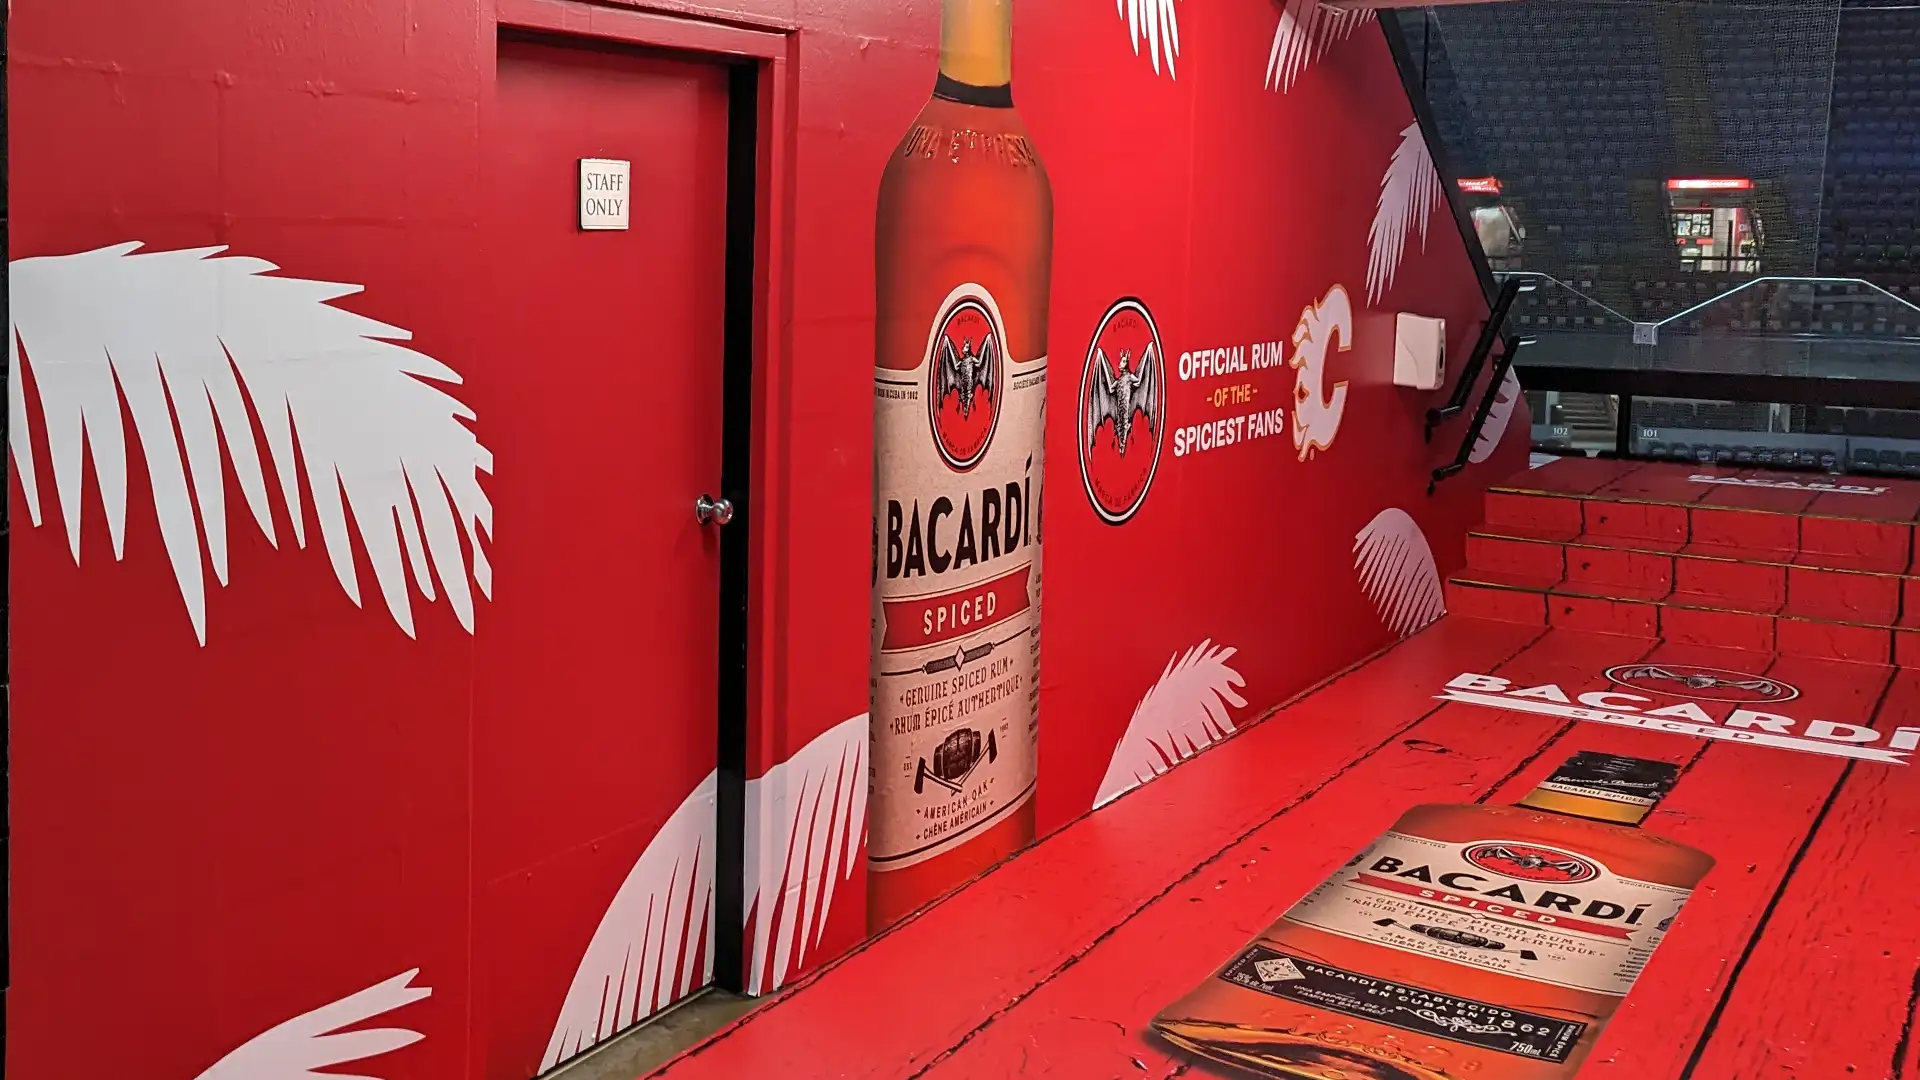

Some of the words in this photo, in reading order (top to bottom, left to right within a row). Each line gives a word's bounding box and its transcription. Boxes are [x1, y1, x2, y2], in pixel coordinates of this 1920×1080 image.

[586, 172, 624, 191] STAFF
[586, 198, 623, 216] ONLY
[1178, 345, 1248, 381] OFFICIAL
[1251, 340, 1284, 370] RUM
[1214, 386, 1229, 408] OF
[1230, 384, 1251, 405] THE
[1174, 416, 1246, 457] SPICIEST
[1248, 407, 1284, 440] FANS
[1553, 427, 1569, 435] 102
[1642, 429, 1658, 437] 101
[886, 450, 1032, 579] BACARDÍ
[923, 591, 997, 636] SPICED
[905, 680, 949, 708] GENUINE
[951, 666, 988, 694] SPICED
[990, 656, 1010, 678] RUM
[894, 711, 921, 736] RHUM
[924, 699, 954, 728] ÉPICÉ
[957, 673, 1020, 717] AUTHENTIQUE
[1570, 710, 1756, 740] SPICED
[923, 795, 968, 819] AMERICAN
[971, 780, 989, 800] OAK
[923, 821, 948, 840] CHÊNE
[949, 801, 988, 830] AMÉRICAIN
[1369, 855, 1652, 927] BACARDÍ
[1419, 889, 1557, 924] SPICED
[1352, 898, 1398, 913] RHUM
[1465, 924, 1599, 957] AUTHENTIQUE
[1375, 897, 1453, 919] GENUINE
[1458, 916, 1528, 936] SPICED
[1535, 932, 1574, 946] RUM
[1385, 931, 1469, 956] AMERICAN
[1478, 954, 1512, 964] OAK
[1293, 985, 1313, 994] UNA
[1314, 990, 1361, 1005] EMPRESA
[1368, 988, 1391, 998] EN
[1398, 996, 1447, 1012] CUBA
[1456, 1009, 1479, 1018] EN
[1486, 1016, 1551, 1037] 1862
[1384, 985, 1512, 1018] ESTABLECIDO
